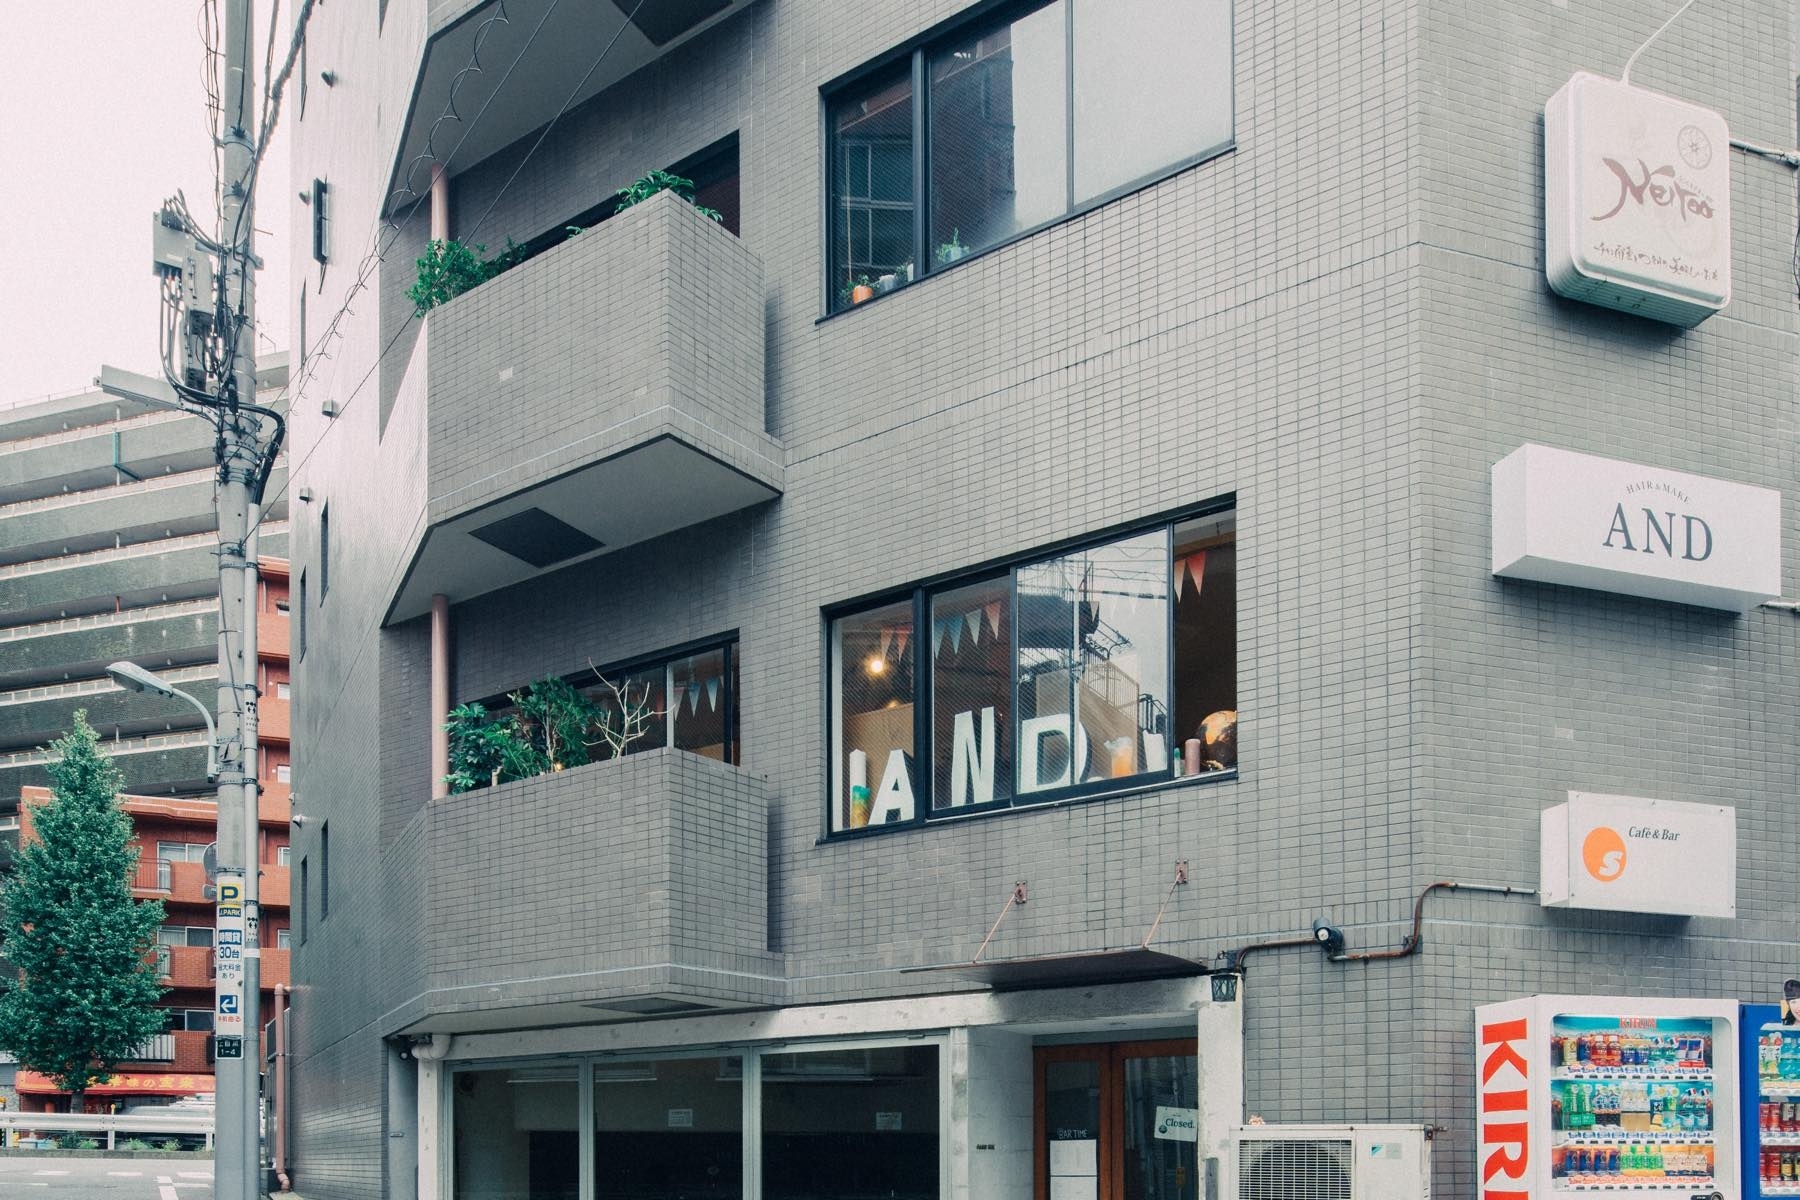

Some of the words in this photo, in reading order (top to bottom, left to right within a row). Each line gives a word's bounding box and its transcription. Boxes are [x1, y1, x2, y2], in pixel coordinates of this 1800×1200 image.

[1626, 480, 1653, 494] HAIR
[1663, 483, 1690, 504] MAKE
[1602, 502, 1713, 562] AND
[1628, 826, 1652, 839] Café
[1652, 829, 1661, 839] &
[1661, 829, 1681, 841] Bar
[221, 886, 239, 903] P
[219, 946, 240, 959] 30台
[222, 972, 235, 980] あり
